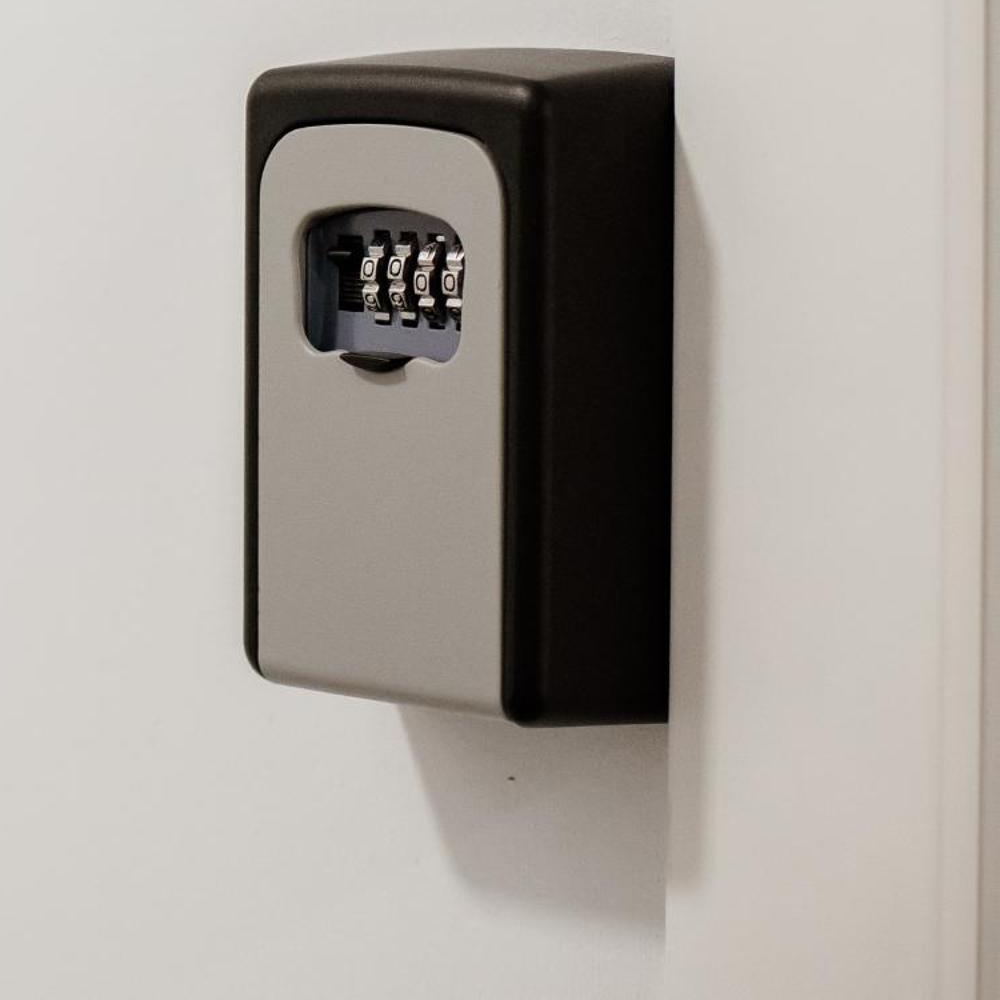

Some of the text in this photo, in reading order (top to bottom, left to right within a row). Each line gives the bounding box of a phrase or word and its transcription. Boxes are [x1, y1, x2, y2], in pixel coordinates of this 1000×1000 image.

[363, 259, 455, 292] 0 0 0 0
